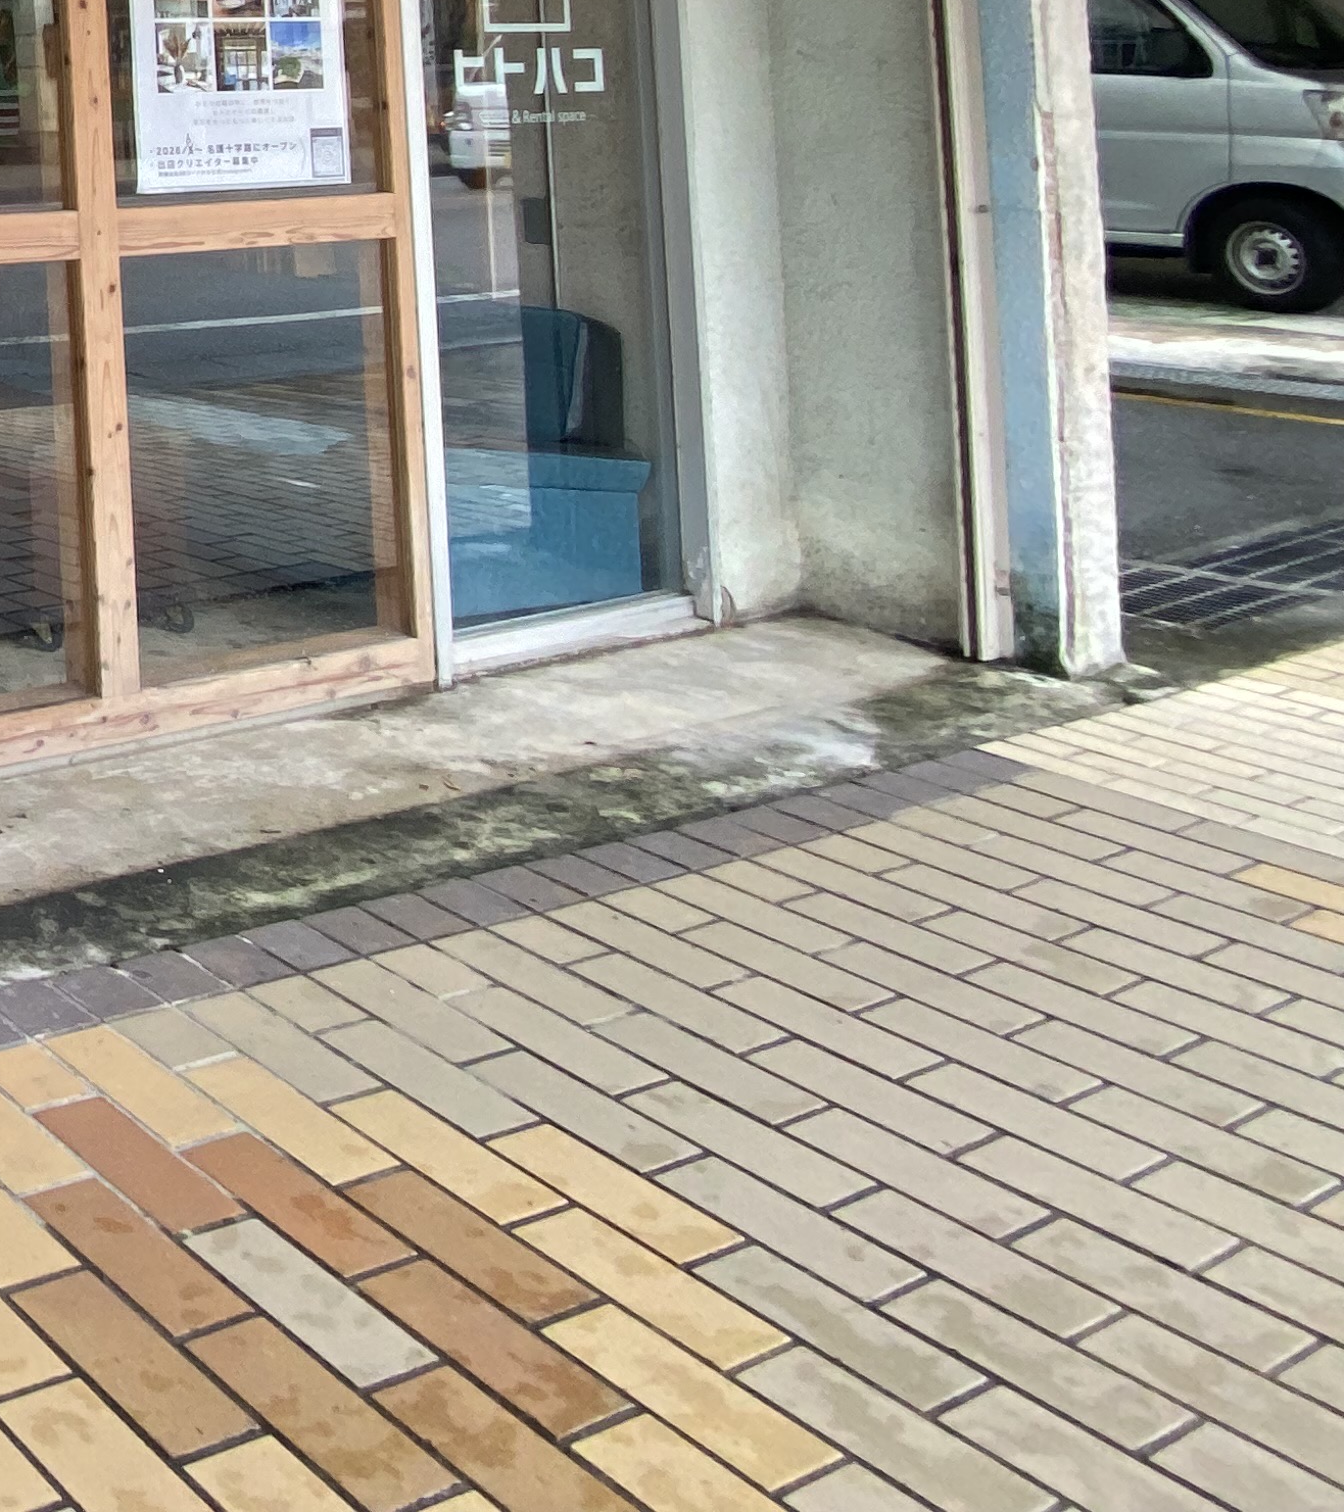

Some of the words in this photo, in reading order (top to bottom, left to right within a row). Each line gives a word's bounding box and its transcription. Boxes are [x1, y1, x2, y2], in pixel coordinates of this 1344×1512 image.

[453, 47, 605, 95] ヒトハコ
[511, 109, 521, 124] &
[523, 109, 555, 124] Rental
[557, 111, 587, 126] space
